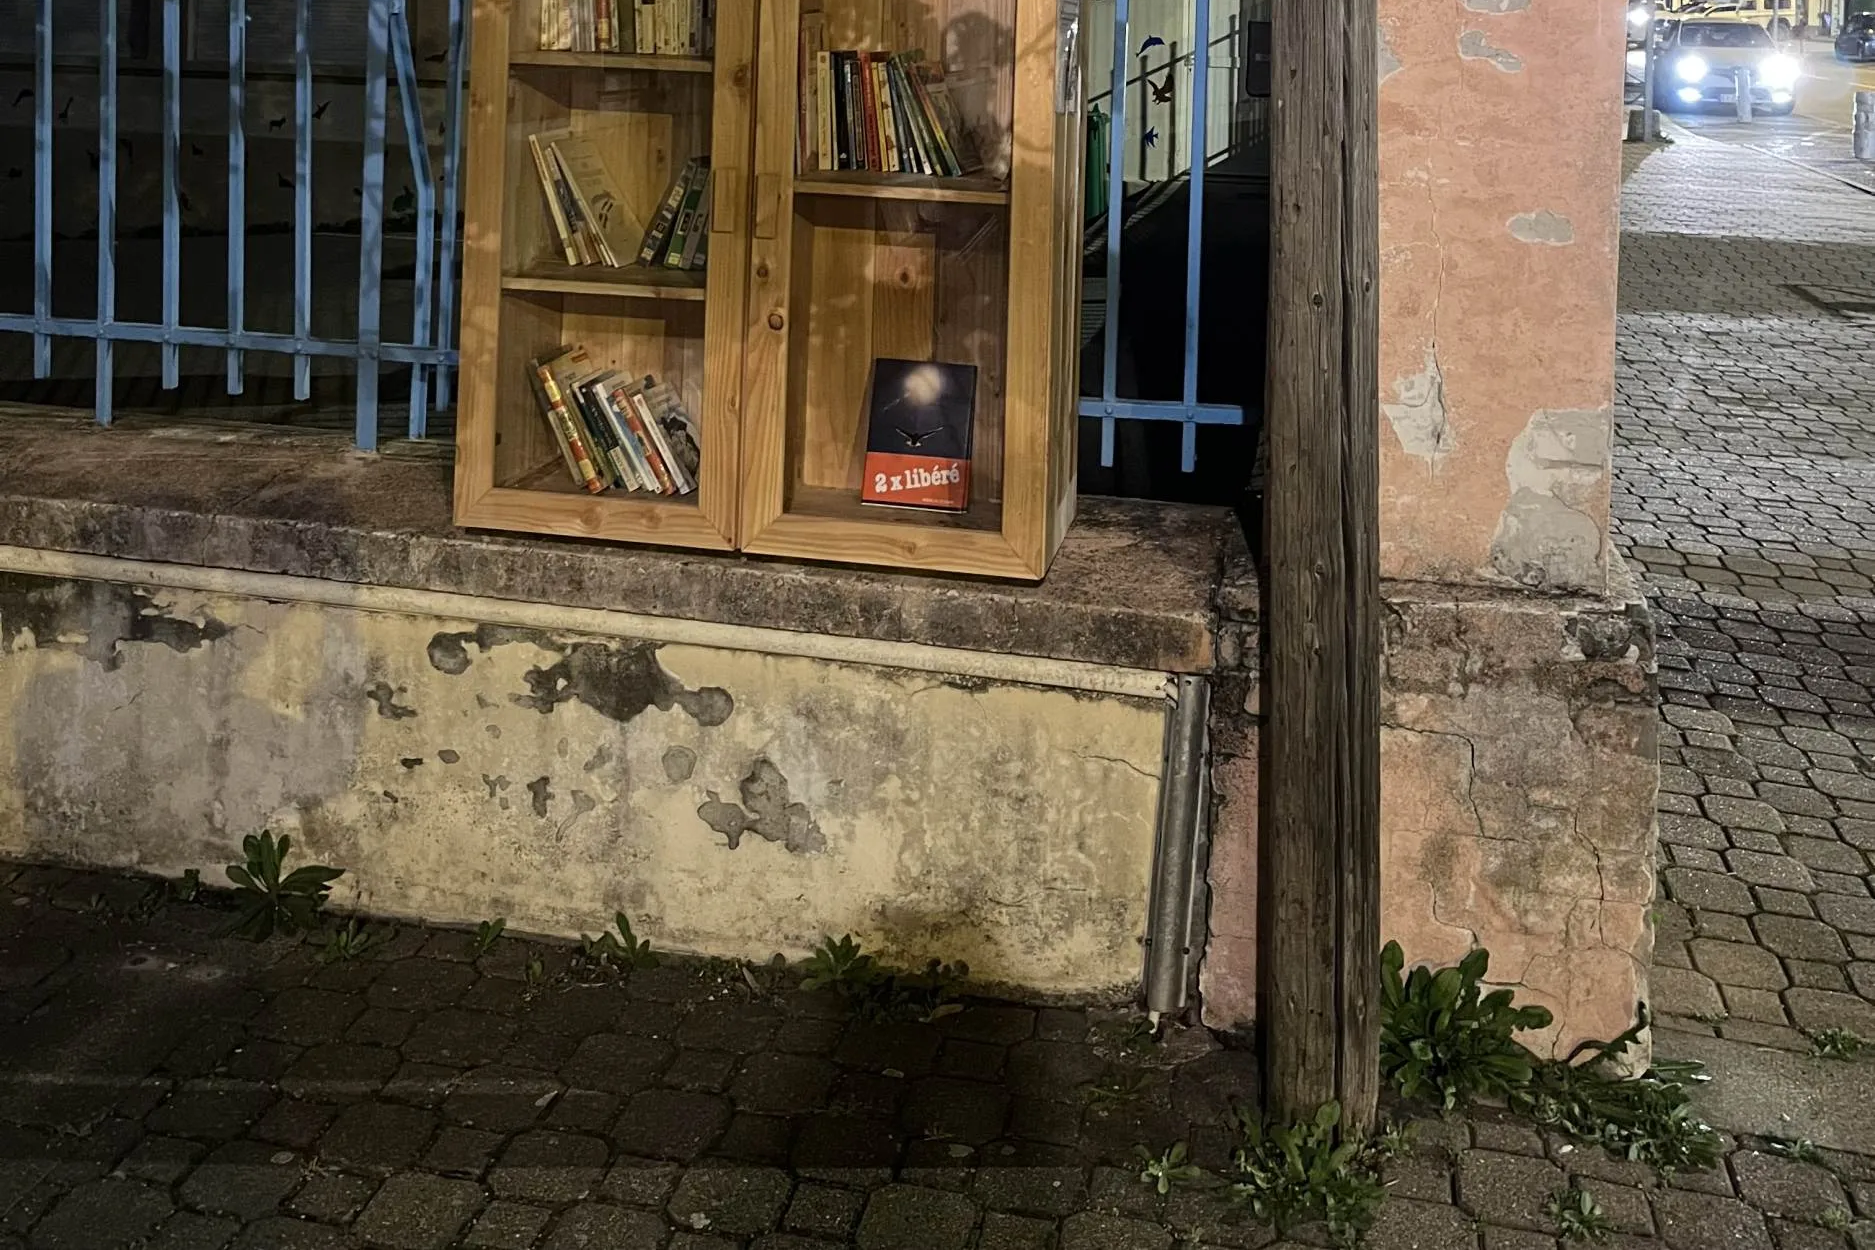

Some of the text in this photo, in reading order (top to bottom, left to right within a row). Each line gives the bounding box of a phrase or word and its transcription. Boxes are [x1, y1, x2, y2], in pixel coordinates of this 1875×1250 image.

[874, 462, 960, 493] 2 x libéré
